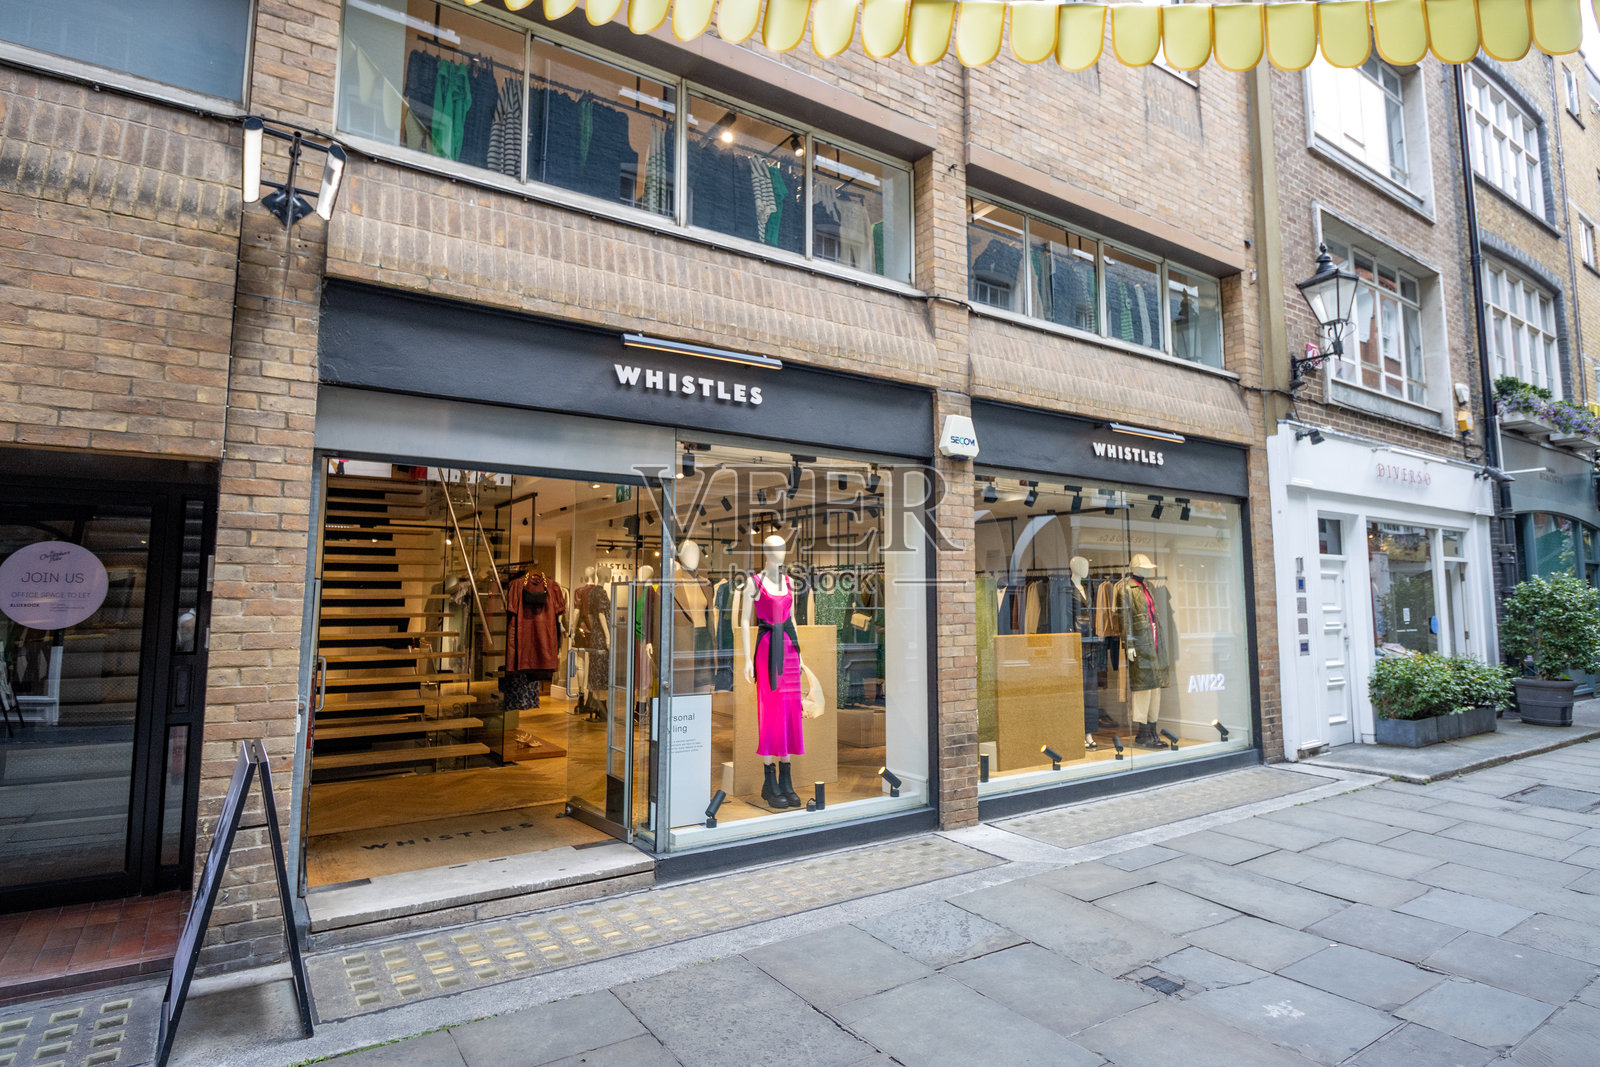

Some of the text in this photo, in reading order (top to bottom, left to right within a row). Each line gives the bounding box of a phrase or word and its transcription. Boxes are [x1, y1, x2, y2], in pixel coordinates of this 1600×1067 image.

[614, 364, 763, 405] WHISTLES
[950, 436, 975, 446] SECOM
[1092, 441, 1164, 466] WHISTLES
[1376, 463, 1431, 486] DIVERSO
[21, 572, 84, 583] JOIN US
[11, 591, 39, 599] OFFICE
[1187, 673, 1225, 693] AW22
[672, 713, 696, 722] sonal
[360, 822, 534, 850] WHISTLES
